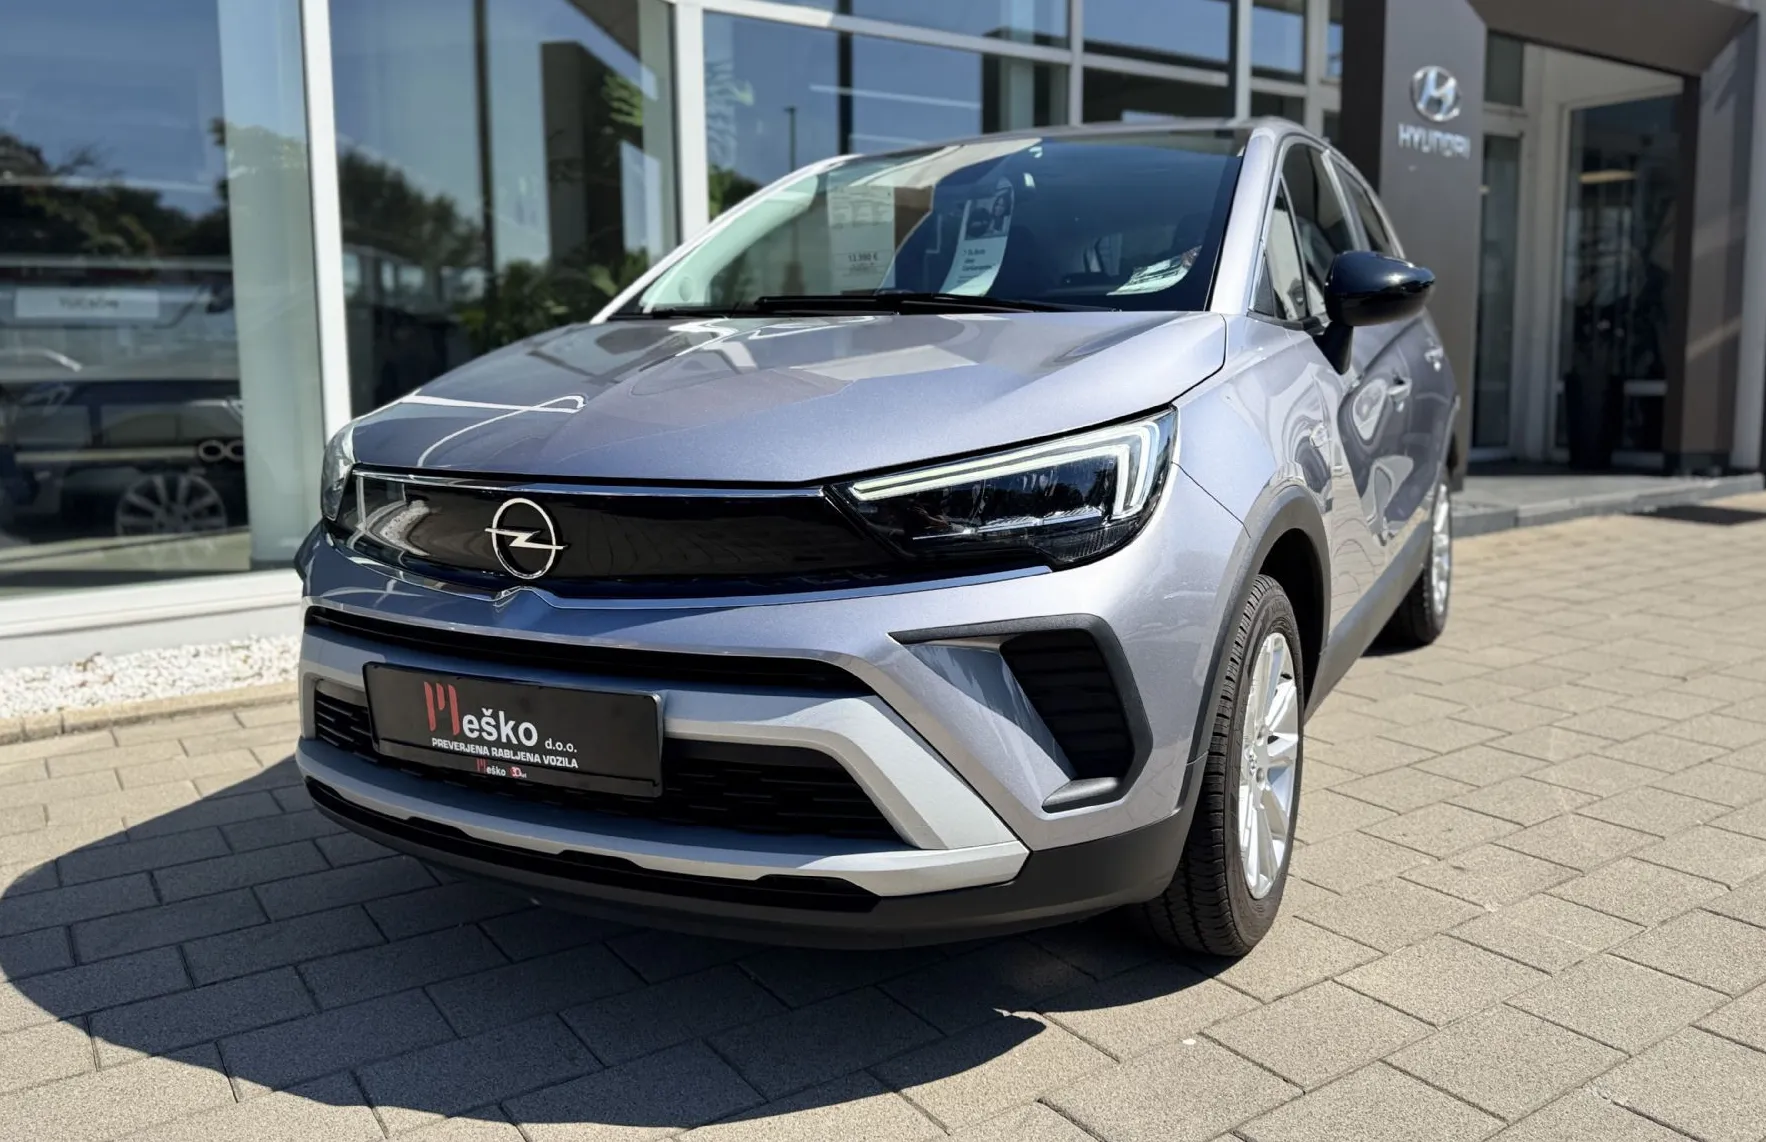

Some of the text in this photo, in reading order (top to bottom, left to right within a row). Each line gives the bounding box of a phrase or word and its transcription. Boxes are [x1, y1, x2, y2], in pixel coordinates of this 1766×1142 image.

[423, 681, 578, 753] Meško d.o.o.
[431, 737, 579, 769] PREVERJENA RABLJENA VOZILA
